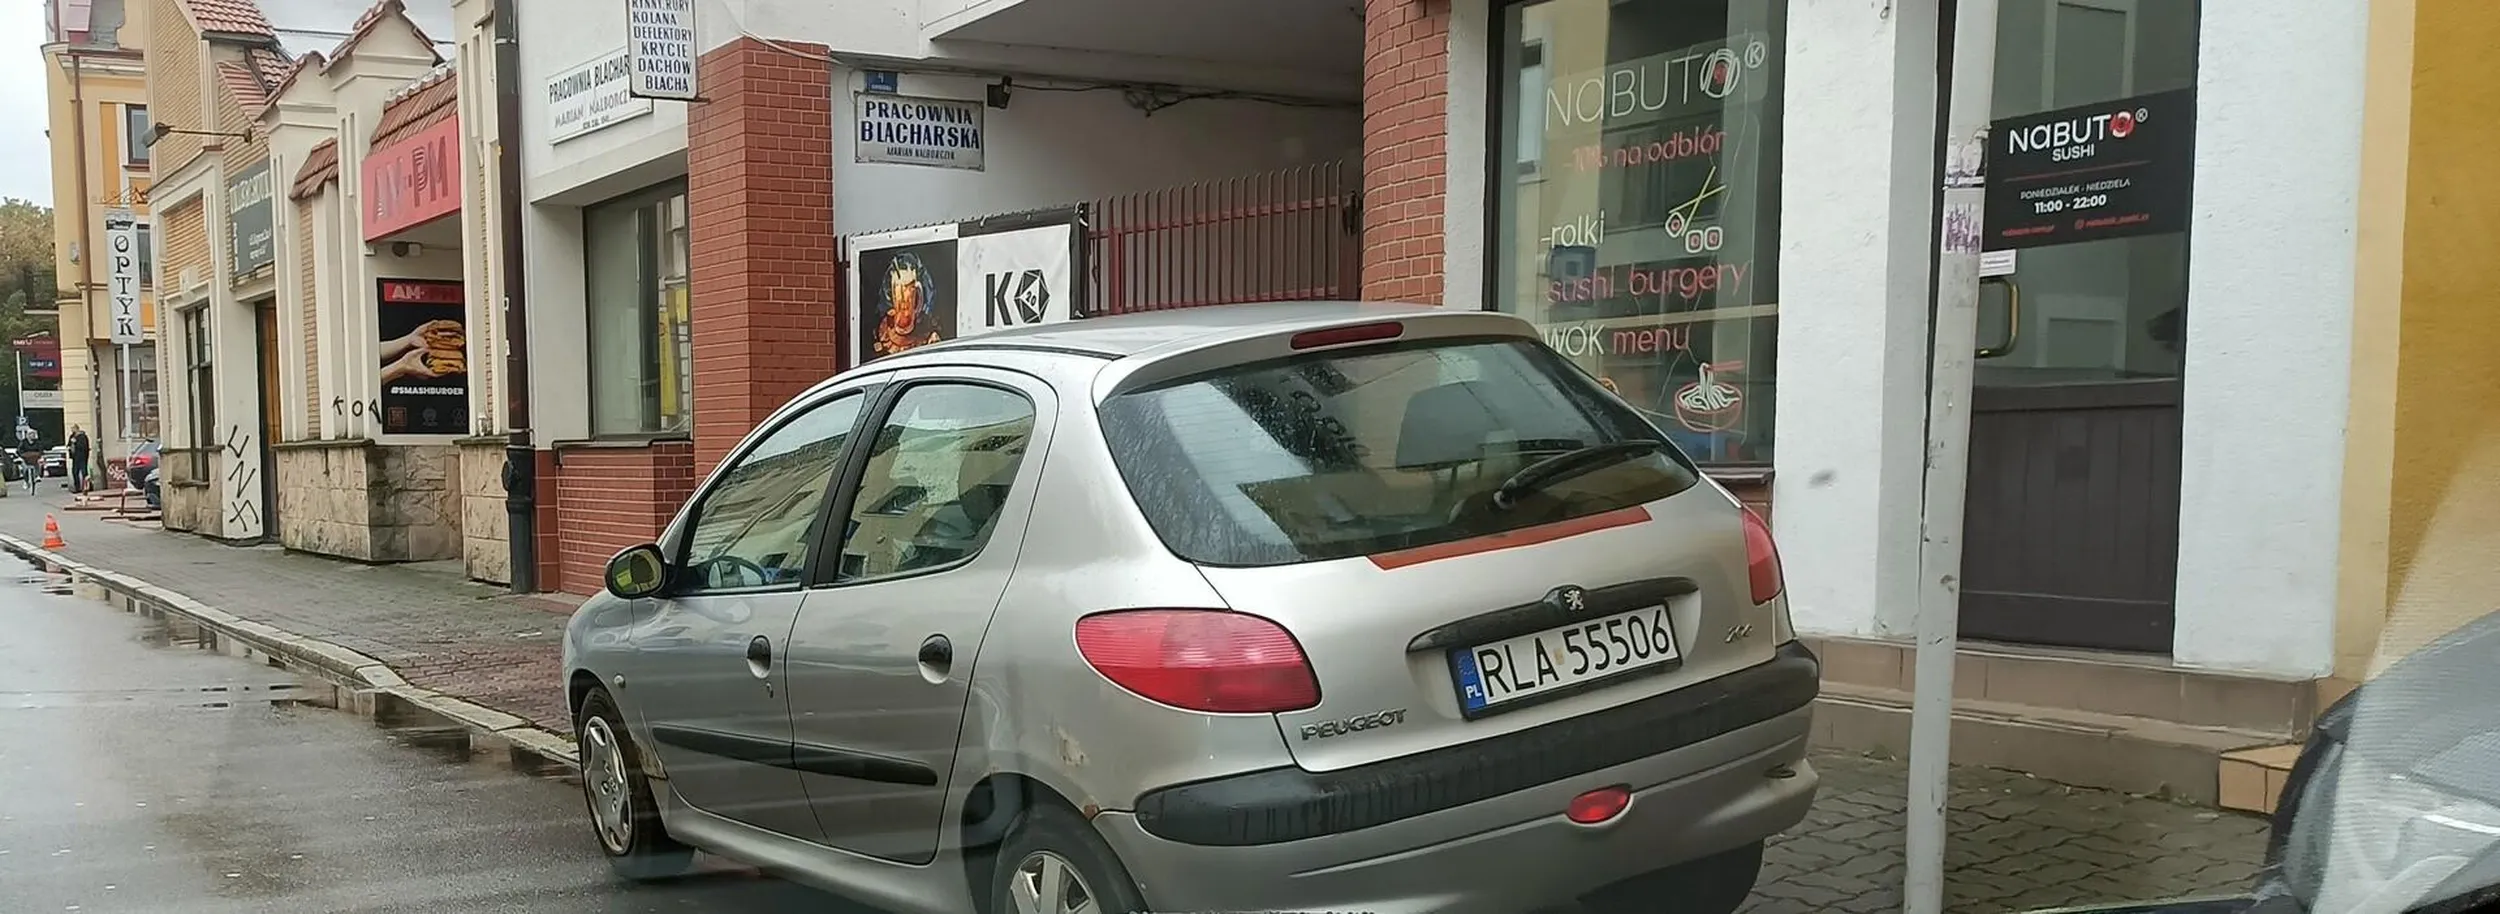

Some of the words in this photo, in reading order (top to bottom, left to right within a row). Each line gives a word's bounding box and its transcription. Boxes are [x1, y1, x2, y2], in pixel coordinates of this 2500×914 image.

[633, 11, 677, 25] KOLANA
[633, 26, 692, 41] DEFLEKTORY
[641, 41, 688, 58] KRYCIE
[549, 69, 592, 105] PRACOWNIA
[594, 54, 630, 88] BLACHAR
[645, 75, 689, 93] BLACHA
[865, 101, 973, 125] PRACOWNIA
[861, 120, 980, 149] BLACHARSKA
[1613, 146, 1641, 168] na
[2052, 143, 2095, 162] SUSHI
[2034, 200, 2063, 214] 11:00
[2073, 194, 2107, 210] 22:00
[115, 235, 136, 336] OPTYK
[1548, 264, 1616, 304] sushi
[1629, 260, 1751, 300] burgery
[1613, 325, 1691, 354] menu
[391, 386, 465, 396] #SMASHBURGER
[1466, 685, 1482, 698] PL
[1477, 637, 1560, 697] RLA
[1562, 610, 1670, 676] 55506
[1301, 708, 1406, 740] PEUGEOT
